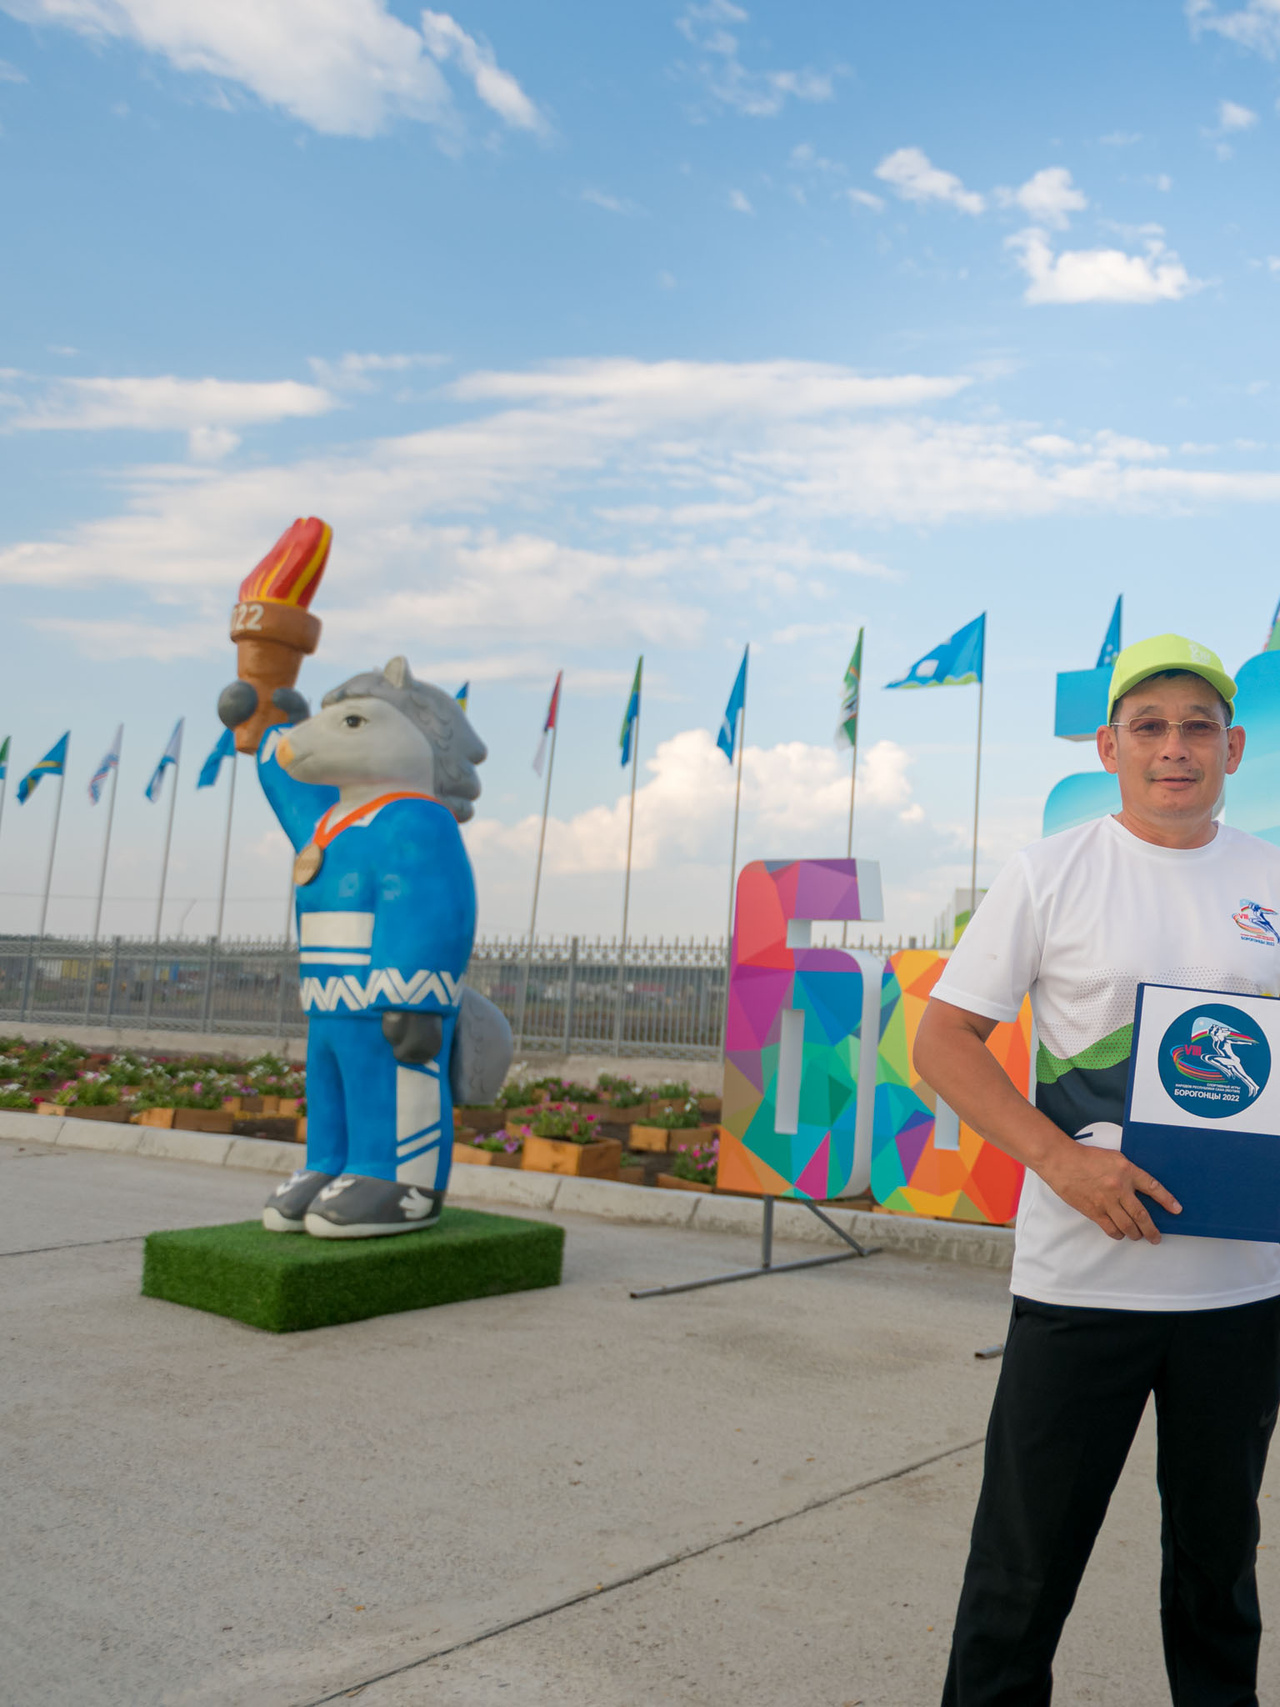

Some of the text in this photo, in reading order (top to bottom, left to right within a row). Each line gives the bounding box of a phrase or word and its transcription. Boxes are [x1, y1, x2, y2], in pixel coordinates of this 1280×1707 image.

[1184, 1044, 1202, 1056] VIII
[1174, 1088, 1240, 1102] БОРОГОНЦЫ 2022
